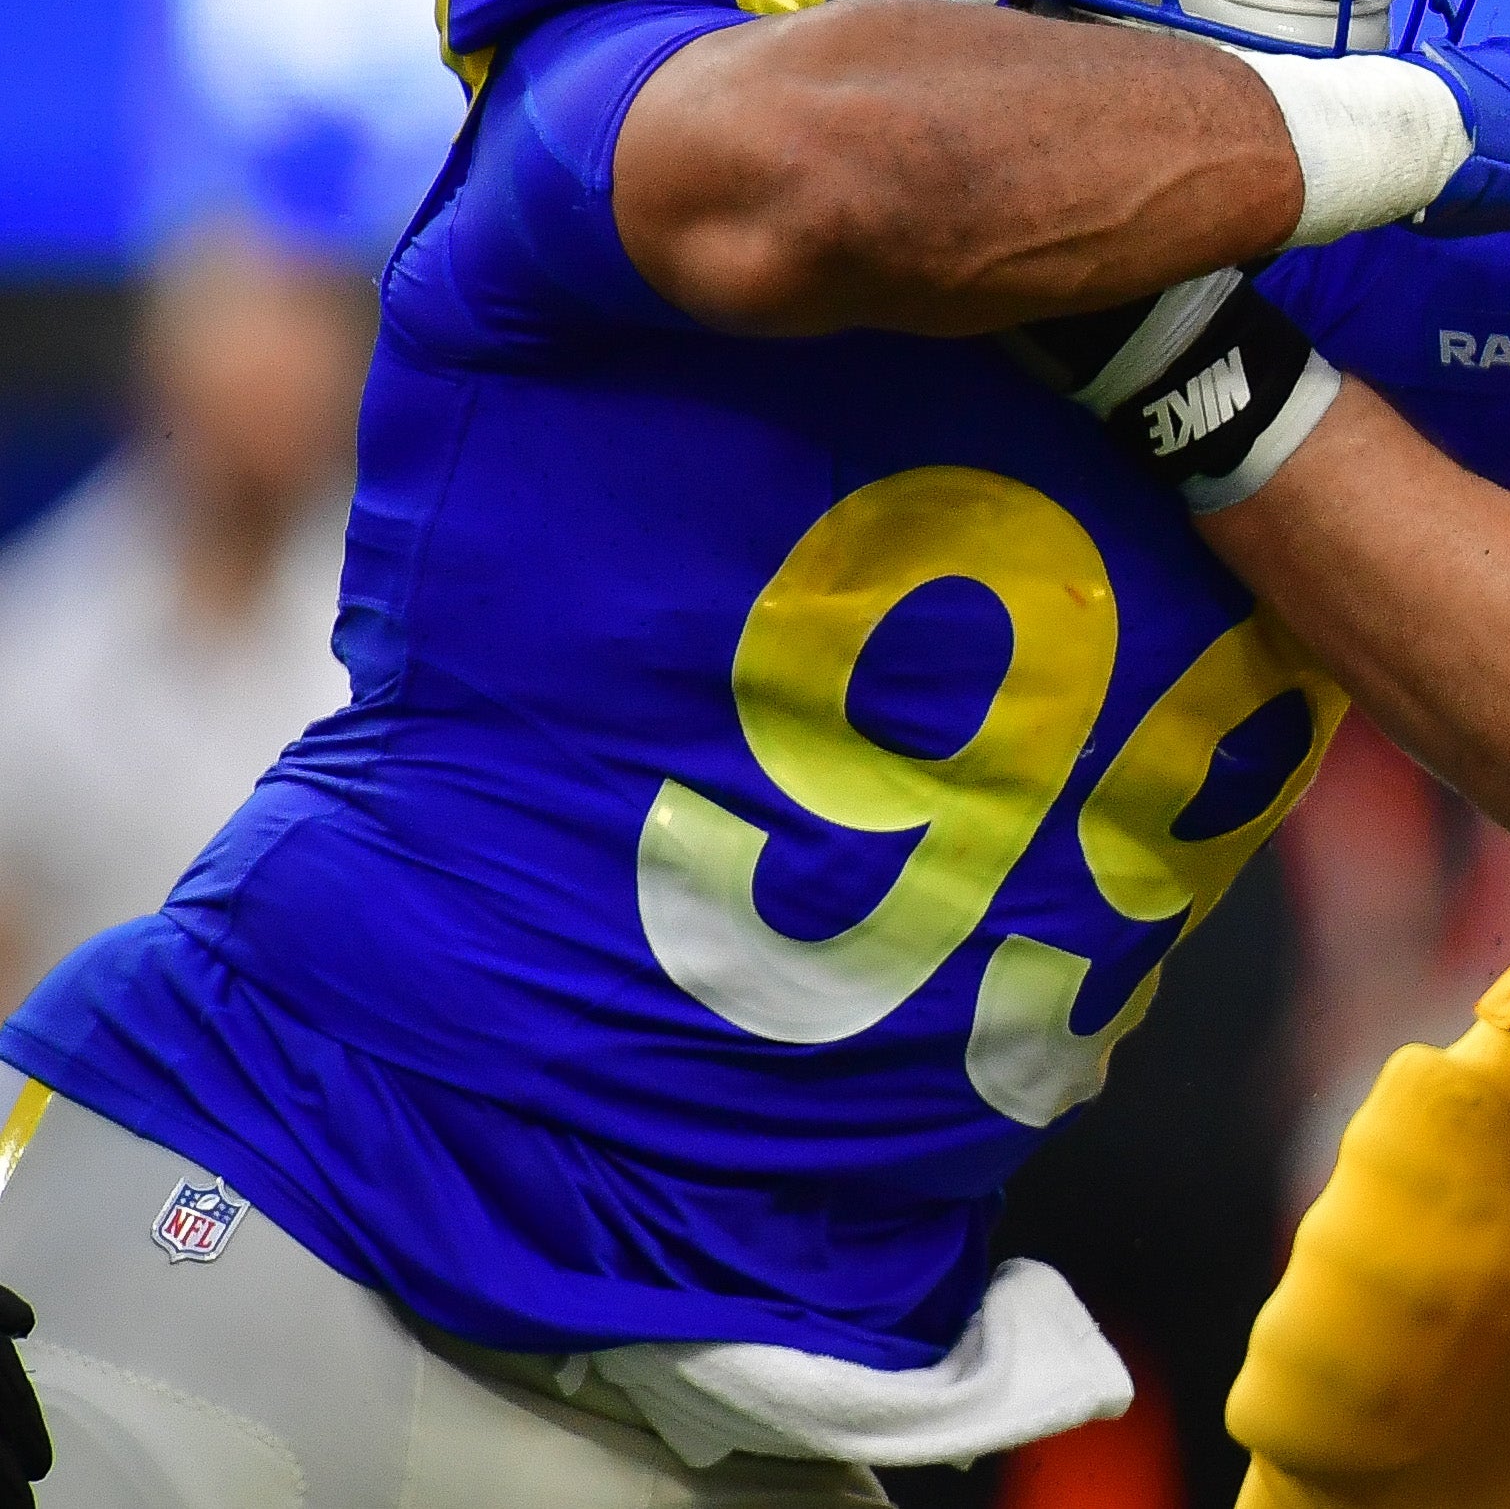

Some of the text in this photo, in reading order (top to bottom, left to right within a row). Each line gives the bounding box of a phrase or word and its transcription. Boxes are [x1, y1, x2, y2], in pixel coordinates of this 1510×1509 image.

[1142, 346, 1251, 457] NIKE
[636, 464, 1352, 1128] 99
[164, 1208, 216, 1249] NFL
